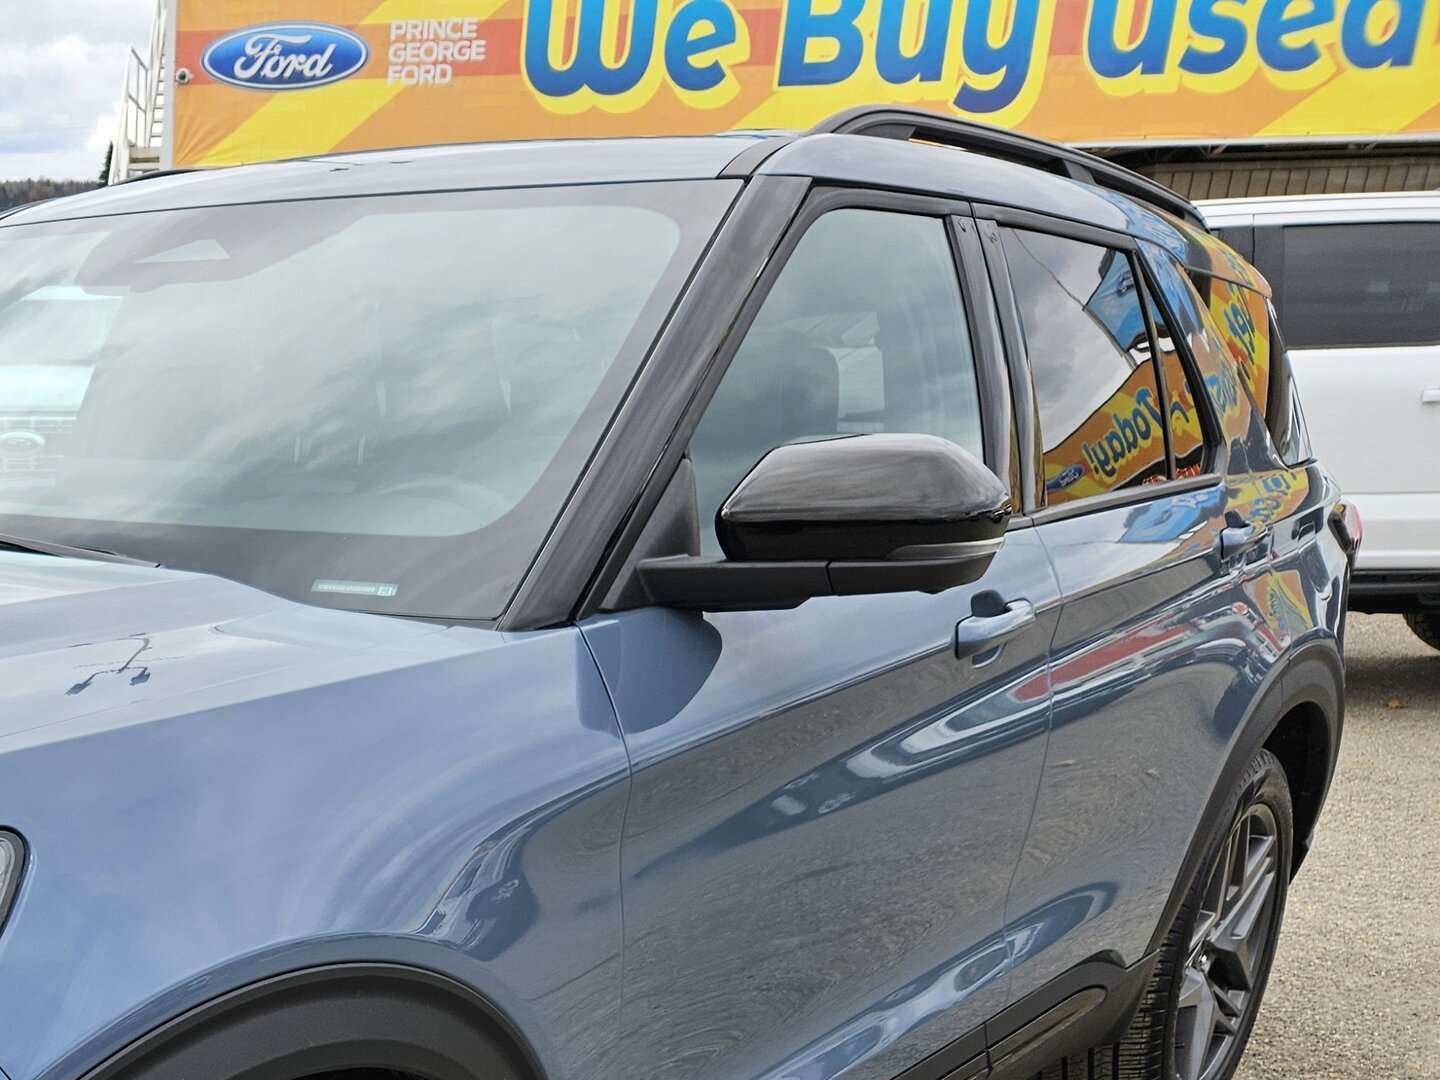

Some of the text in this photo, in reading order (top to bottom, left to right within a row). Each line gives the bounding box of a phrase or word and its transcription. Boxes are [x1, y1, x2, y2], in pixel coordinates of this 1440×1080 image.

[389, 17, 479, 42] PRINCE
[233, 33, 338, 80] Ford
[388, 40, 487, 63] GEORGE
[524, 0, 738, 97] We
[778, 0, 1040, 114] Buy
[387, 64, 454, 87] FORD
